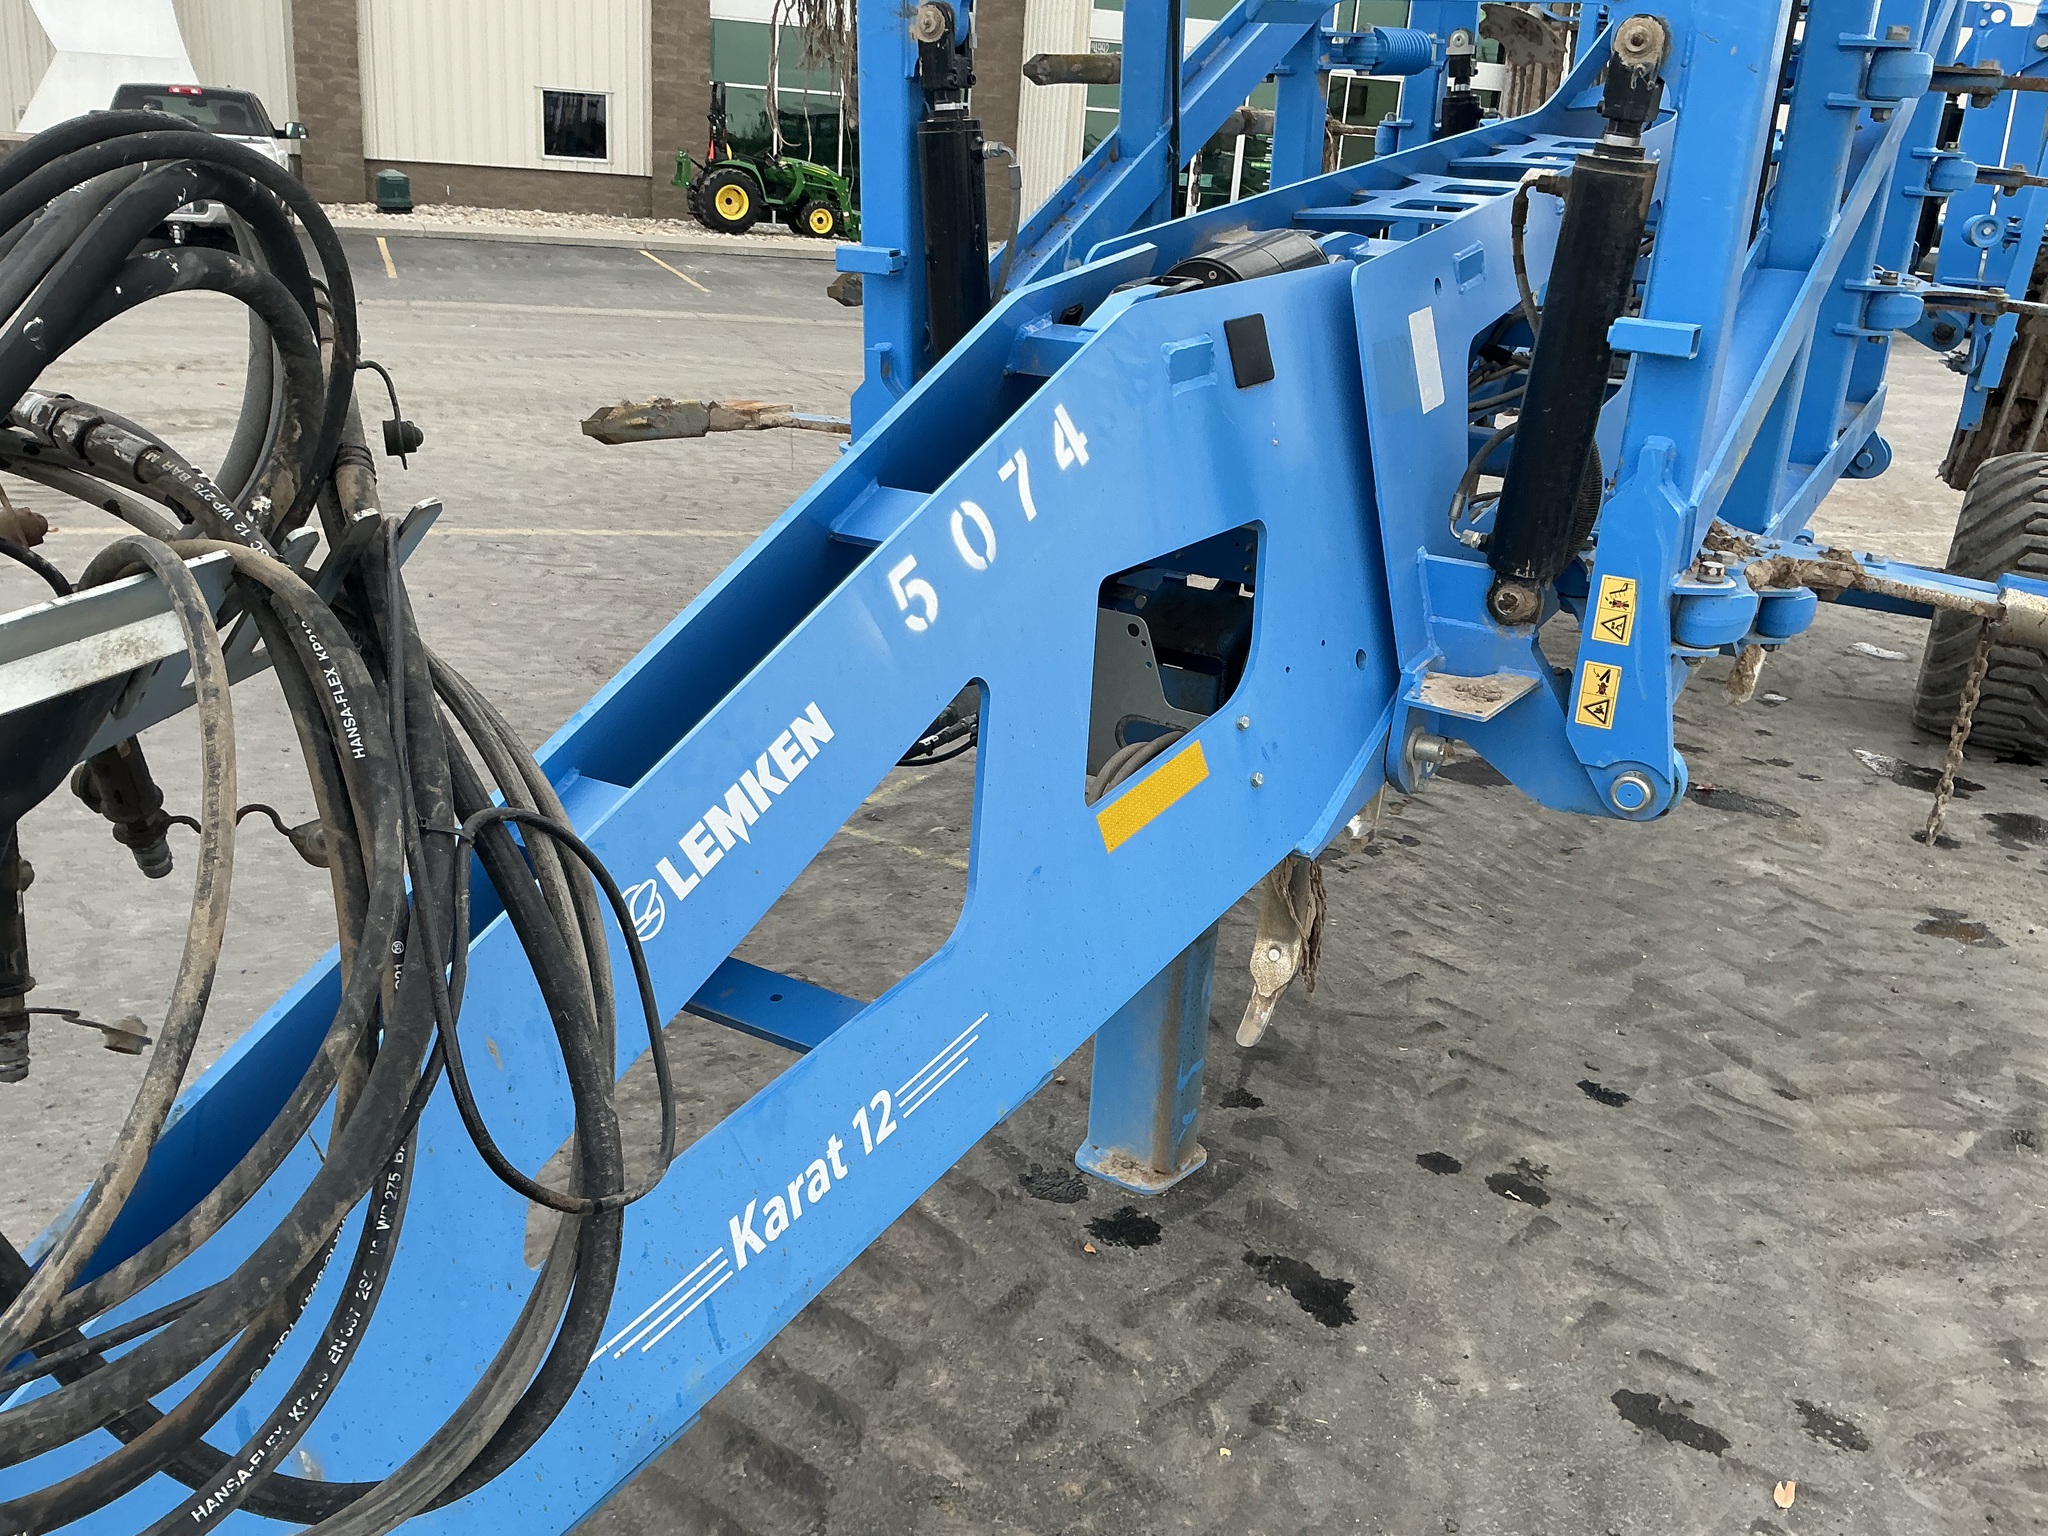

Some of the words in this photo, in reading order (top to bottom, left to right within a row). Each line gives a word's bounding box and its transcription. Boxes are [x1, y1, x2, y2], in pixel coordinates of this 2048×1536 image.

[161, 460, 192, 483] BAR
[193, 481, 217, 502] 275
[212, 501, 235, 521] WP
[234, 521, 251, 537] 12
[323, 666, 366, 758] HANSA-FLEX
[655, 701, 836, 901] LEMKEN
[728, 1134, 848, 1271] Karat
[852, 1089, 898, 1156] 12
[328, 1338, 348, 1365] EN
[384, 1172, 402, 1201] 275
